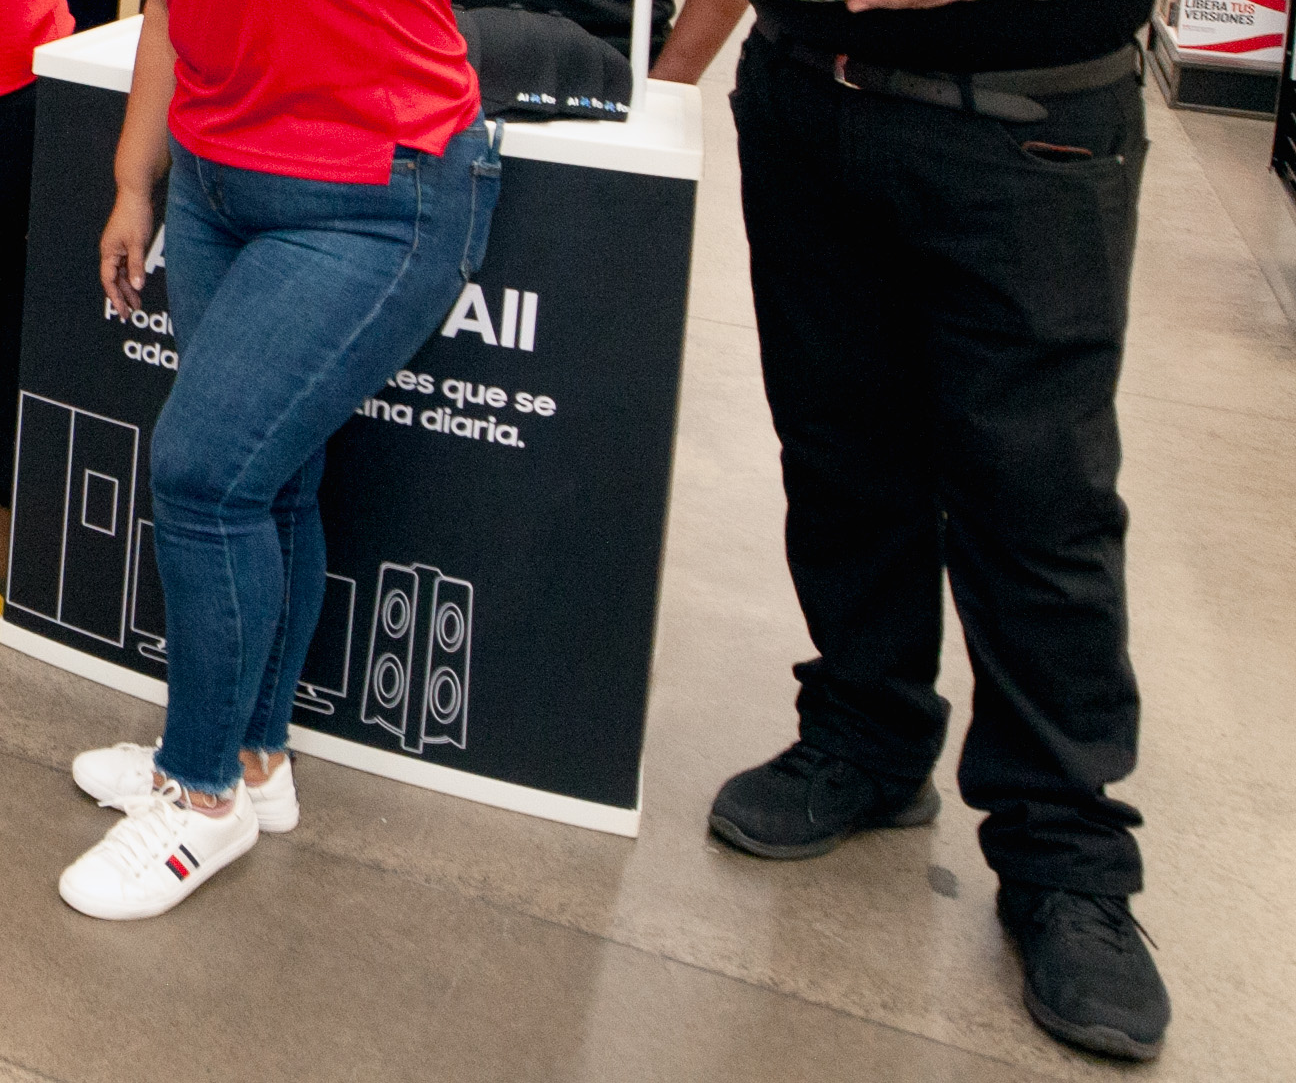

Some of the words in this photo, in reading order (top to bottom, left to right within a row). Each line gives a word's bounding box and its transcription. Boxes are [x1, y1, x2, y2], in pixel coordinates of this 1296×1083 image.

[1184, 9, 1255, 26] VERSIONES
[1230, 2, 1256, 15] TUS
[591, 98, 604, 109] fo
[441, 282, 539, 352] All
[123, 338, 178, 371] ada
[442, 378, 507, 410] que
[514, 389, 557, 417] se
[420, 406, 525, 449] diaria.
